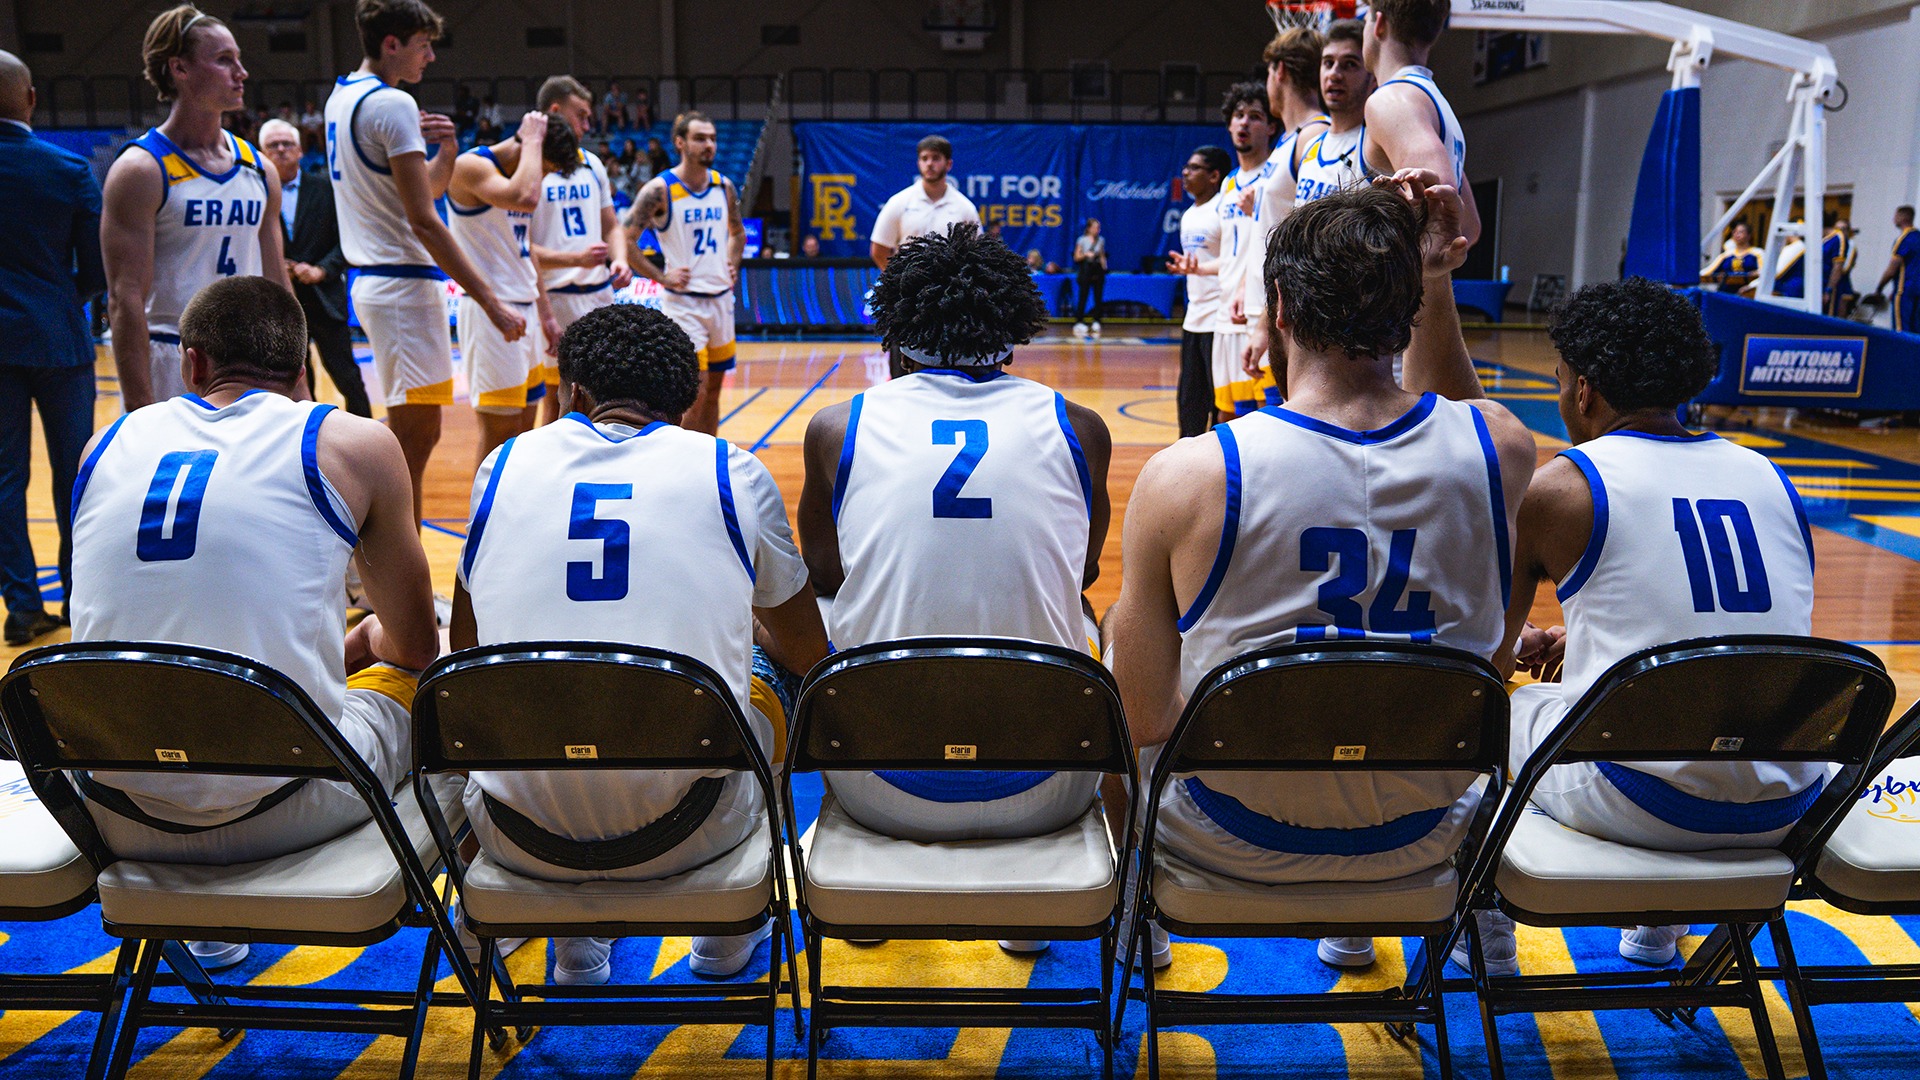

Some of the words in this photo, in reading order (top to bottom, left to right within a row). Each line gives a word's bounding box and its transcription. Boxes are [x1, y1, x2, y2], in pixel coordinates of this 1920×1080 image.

[546, 184, 591, 202] ERAU
[966, 175, 994, 198] IT
[1001, 175, 1062, 198] FOR
[184, 199, 262, 227] ERAU
[562, 206, 586, 236] 13
[684, 207, 722, 223] ERAU
[693, 227, 717, 255] 24
[217, 236, 236, 277] 4
[1766, 349, 1841, 367] DAYTONA
[1750, 365, 1854, 385] MITSUBISHI
[931, 419, 992, 518] 2
[136, 448, 219, 562] 0
[566, 481, 633, 602] 5
[1672, 497, 1772, 613] 10
[1295, 526, 1438, 644] 34
[570, 746, 592, 755] clarin
[950, 746, 971, 754] clarin
